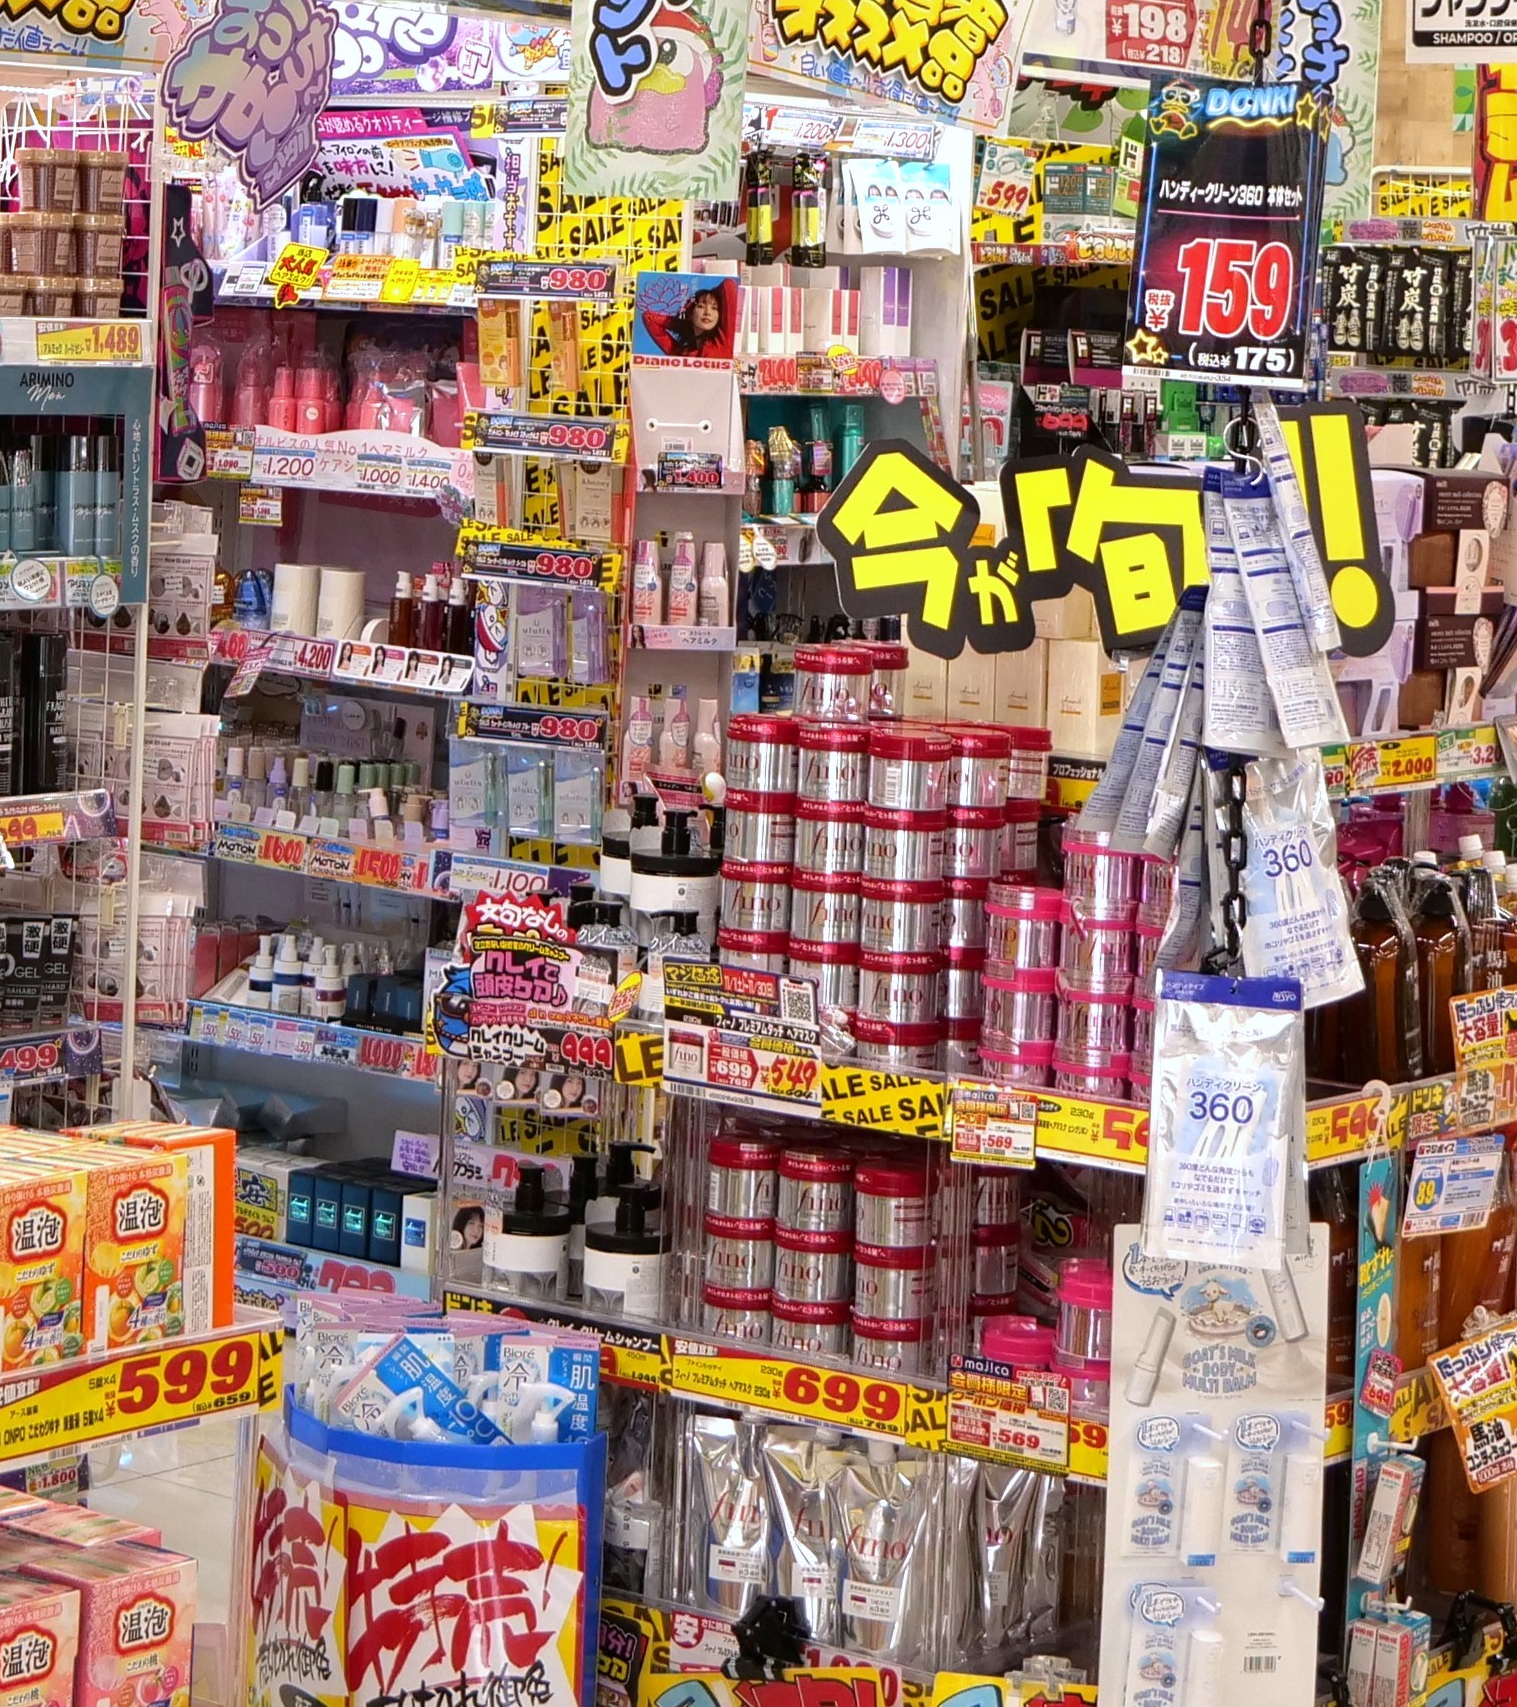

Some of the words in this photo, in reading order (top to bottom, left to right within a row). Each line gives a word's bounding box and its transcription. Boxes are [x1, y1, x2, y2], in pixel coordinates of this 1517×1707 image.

[1433, 31, 1493, 45] SHAMPOO
[19, 372, 75, 390] ARIMINO
[1263, 844, 1313, 878] 360
[1189, 1092, 1252, 1125] 360
[117, 1195, 163, 1232] 温泡
[14, 1215, 61, 1251] 温泡
